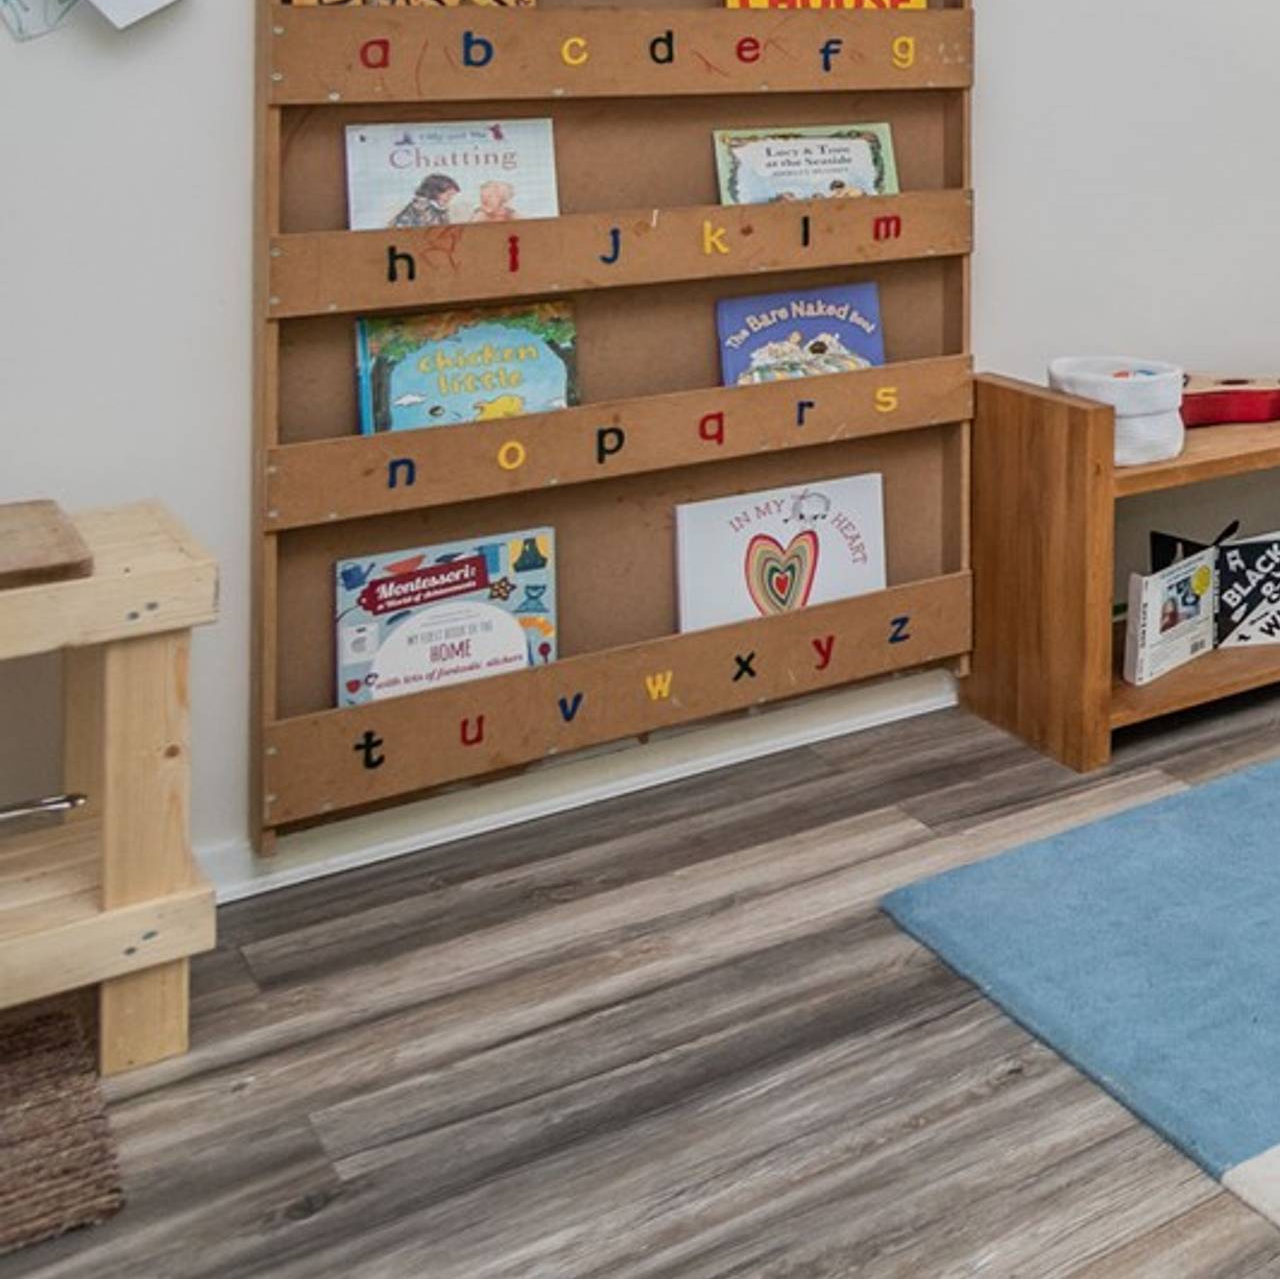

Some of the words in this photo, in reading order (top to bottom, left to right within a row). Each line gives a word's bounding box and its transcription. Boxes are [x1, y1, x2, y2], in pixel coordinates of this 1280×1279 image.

[360, 39, 390, 69] a
[462, 30, 494, 68] b
[561, 37, 588, 66] c
[649, 29, 675, 65] d
[735, 36, 761, 64] e
[819, 38, 843, 72] f
[892, 36, 914, 67] g
[389, 143, 518, 170] Chatting
[387, 245, 416, 283] h
[508, 235, 520, 273] i
[704, 222, 729, 254] k
[873, 215, 902, 242] m
[725, 329, 750, 349] The
[745, 307, 789, 333] Bare
[790, 299, 850, 320] Naked
[417, 343, 539, 373] chicken
[438, 367, 523, 395] little
[387, 458, 416, 489] n
[498, 441, 526, 470] o
[597, 426, 626, 465] p
[698, 411, 724, 446] q
[796, 400, 815, 427] r
[875, 386, 898, 413] s
[729, 511, 751, 532] IN
[755, 499, 786, 519] MY
[830, 512, 868, 565] HEART
[429, 638, 473, 663] HOME
[354, 730, 386, 770] t
[460, 714, 485, 746] u
[558, 692, 583, 723] v
[646, 671, 673, 700] w
[732, 651, 757, 683] x
[812, 635, 835, 671] y
[887, 616, 911, 645] z
